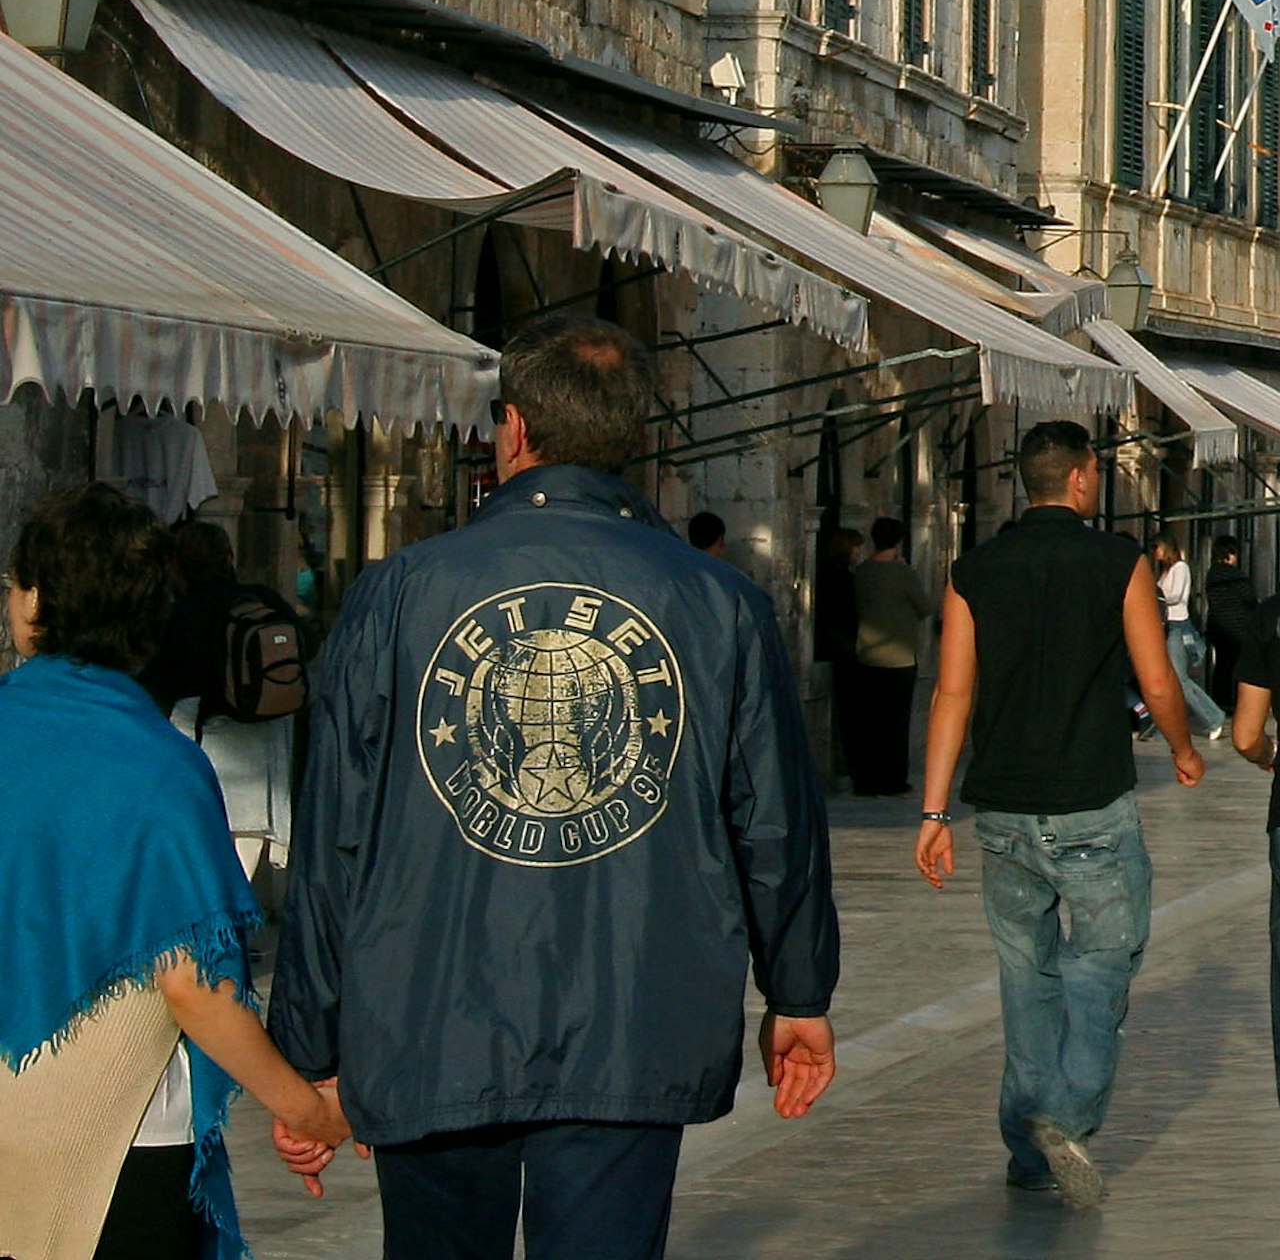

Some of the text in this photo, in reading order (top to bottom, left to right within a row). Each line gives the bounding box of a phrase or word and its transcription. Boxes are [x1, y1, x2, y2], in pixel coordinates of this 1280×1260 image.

[435, 596, 675, 697] JET SET
[444, 759, 546, 855] WORLD
[559, 799, 630, 854] CUP
